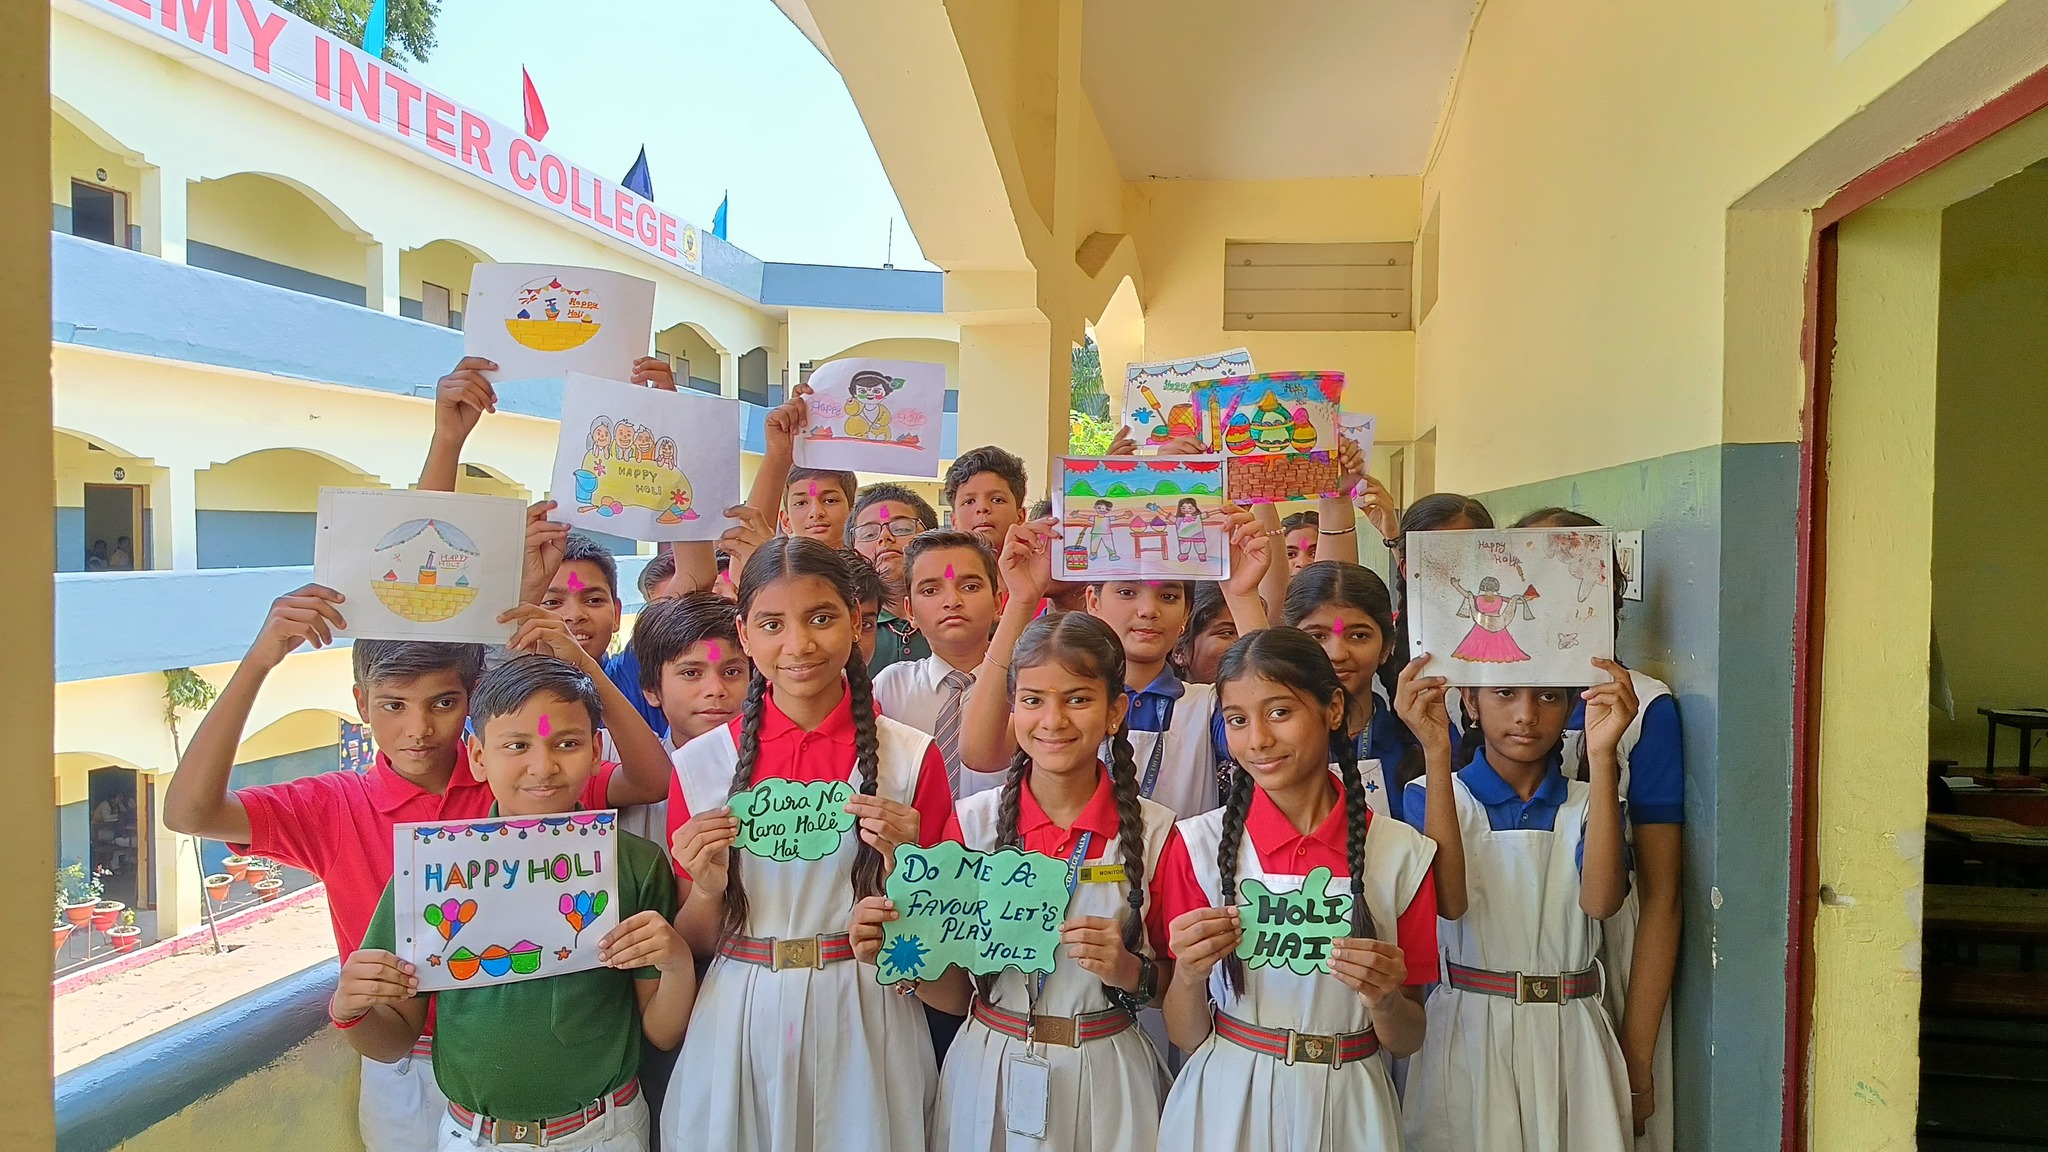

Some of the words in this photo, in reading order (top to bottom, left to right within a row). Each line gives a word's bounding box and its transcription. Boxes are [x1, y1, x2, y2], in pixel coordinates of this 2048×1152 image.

[108, 0, 287, 74] MY
[315, 35, 493, 174] INTER
[509, 138, 677, 257] COLLEGE
[618, 466, 658, 482] HAPPY
[636, 485, 662, 496] HOLI
[1478, 540, 1506, 553] Happy
[748, 786, 811, 817] Bura
[816, 781, 846, 811] Na
[736, 818, 786, 842] Mano
[425, 859, 520, 892] HAPPY
[528, 850, 601, 883] HOLI
[954, 857, 993, 882] ME
[906, 889, 991, 926] FAVOUR
[1000, 901, 1058, 931] LET'S
[1257, 895, 1343, 925] HOLI
[940, 917, 992, 943] PLAY
[980, 942, 1036, 960] HOLI
[1253, 931, 1331, 960] HAI
